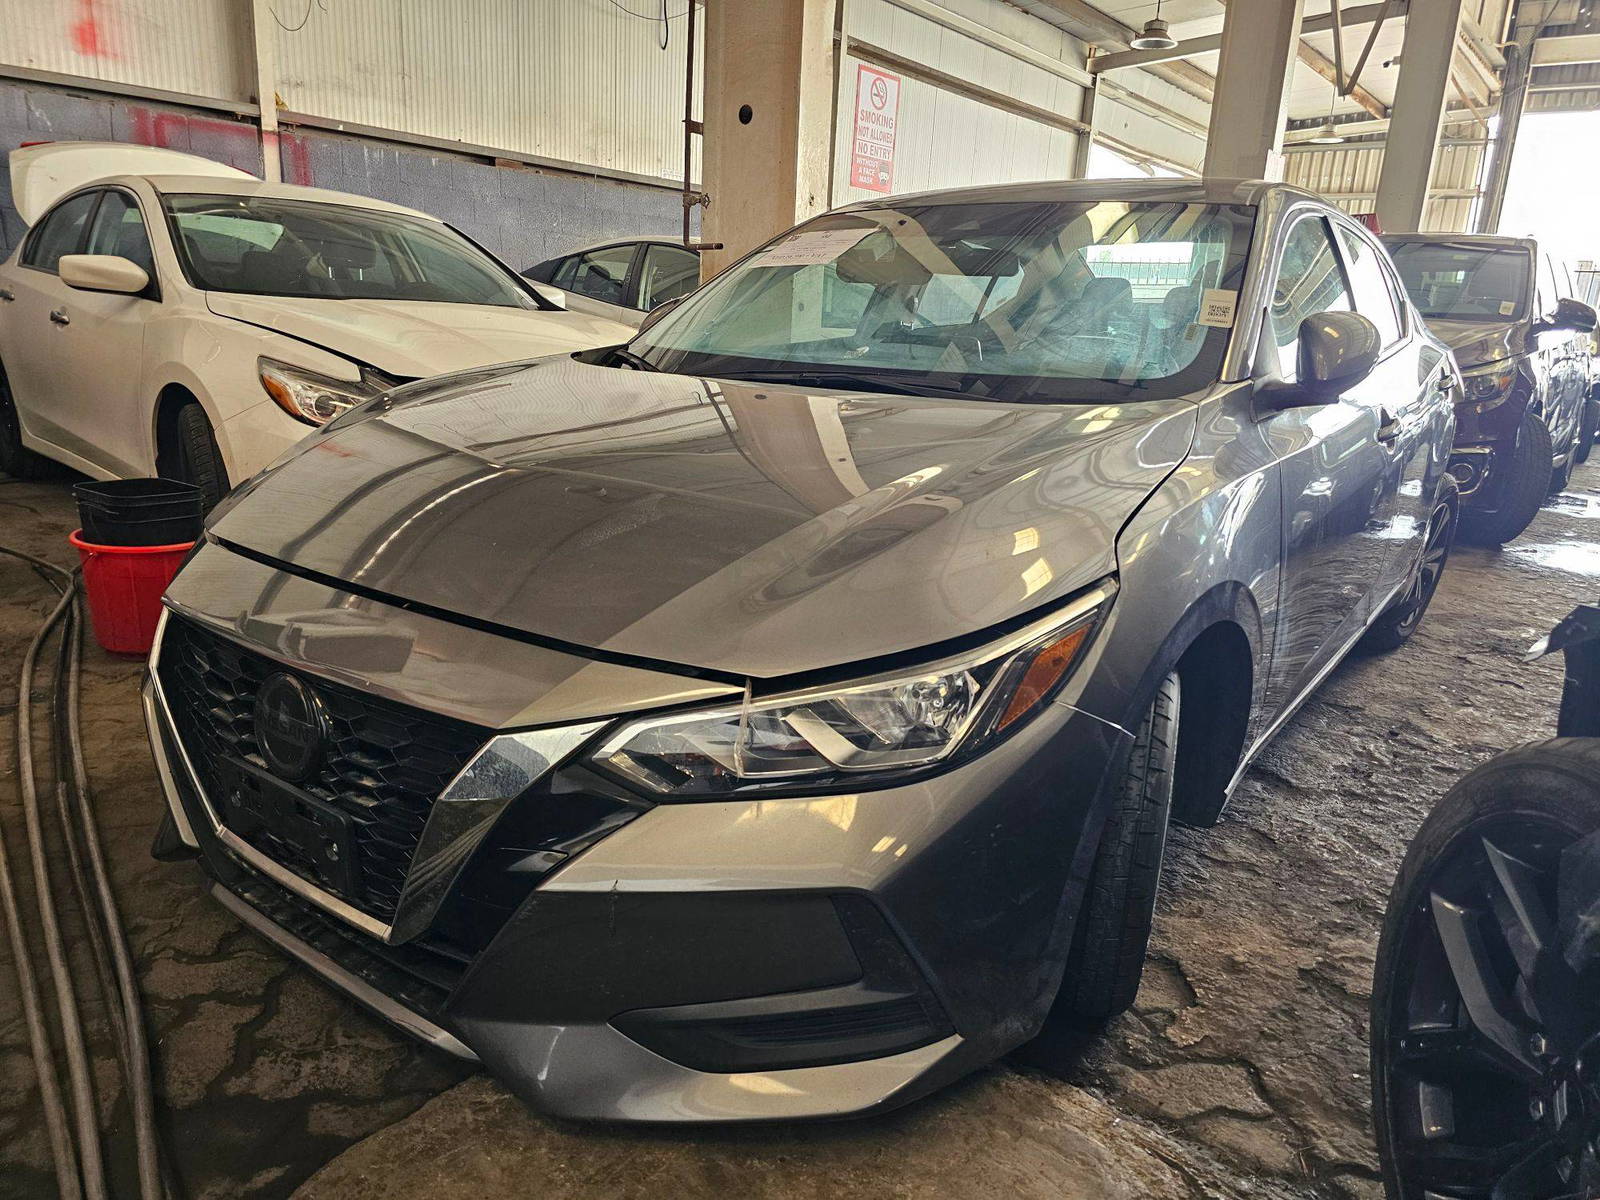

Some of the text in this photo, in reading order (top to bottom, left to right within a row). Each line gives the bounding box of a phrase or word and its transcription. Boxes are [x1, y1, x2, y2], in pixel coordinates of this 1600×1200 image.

[860, 109, 894, 129] SMOKING
[858, 125, 893, 144] NOT ALLOWED
[857, 142, 892, 160] NO ENTRY
